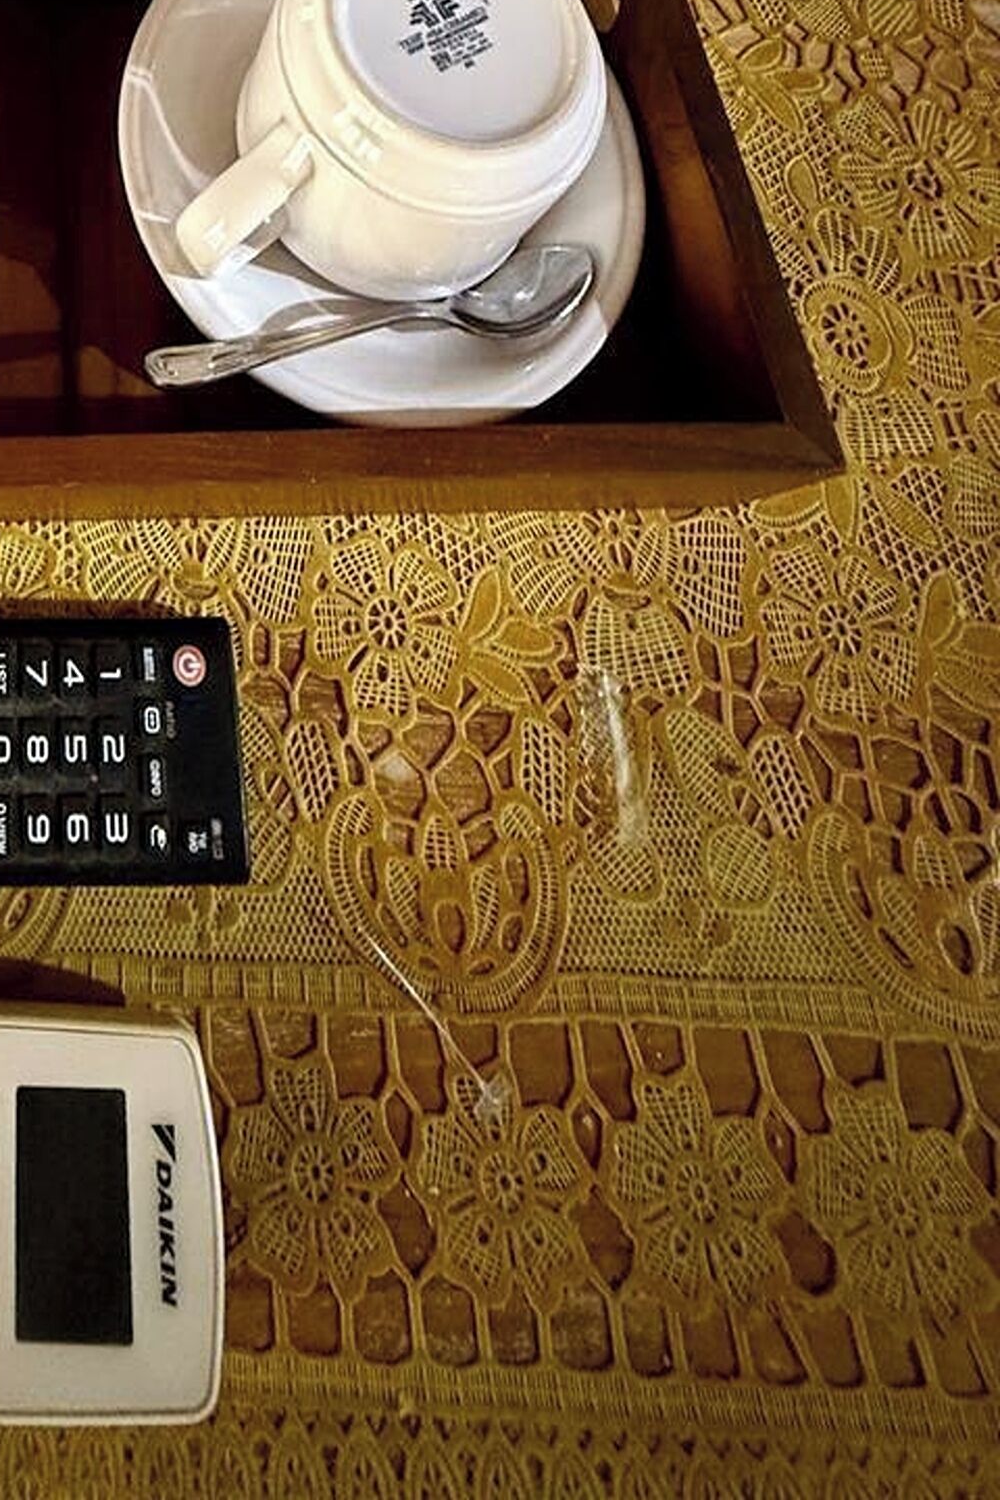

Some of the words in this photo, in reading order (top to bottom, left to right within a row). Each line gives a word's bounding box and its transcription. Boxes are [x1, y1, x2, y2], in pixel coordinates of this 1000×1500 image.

[26, 661, 48, 687] 7
[63, 660, 85, 687] 4
[100, 667, 122, 680] 1
[27, 735, 49, 764] 8
[65, 735, 87, 763] 5
[103, 735, 125, 763] 2
[28, 815, 50, 843] 9
[67, 814, 90, 843] 6
[105, 814, 128, 842] 3
[156, 1160, 181, 1308] DAIKIN
